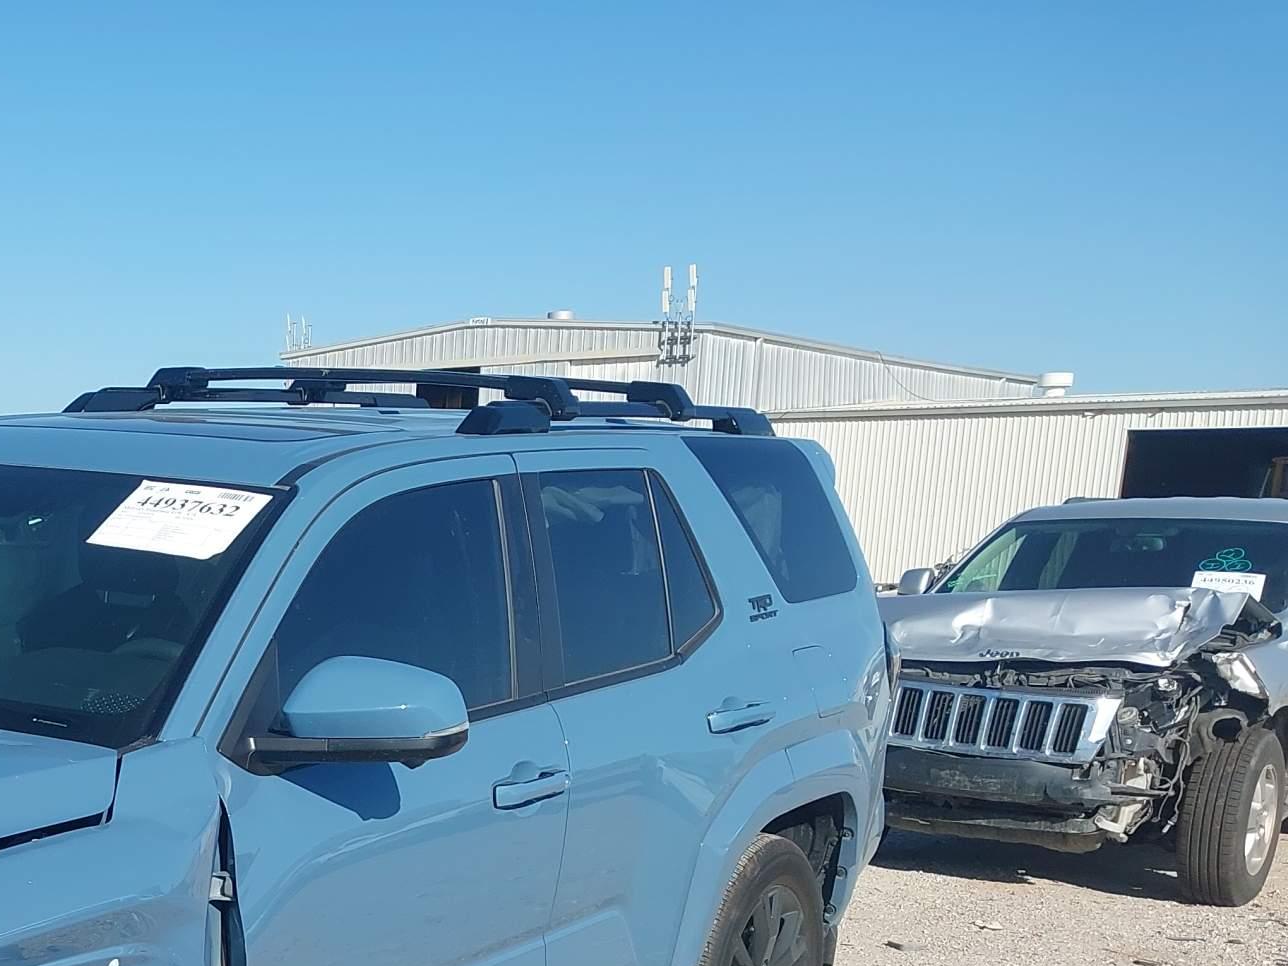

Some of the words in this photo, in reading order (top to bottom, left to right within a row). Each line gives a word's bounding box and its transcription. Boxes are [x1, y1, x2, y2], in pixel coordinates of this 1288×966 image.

[137, 496, 241, 517] 44937632
[748, 594, 772, 612] TRD
[749, 610, 778, 622] SPORT
